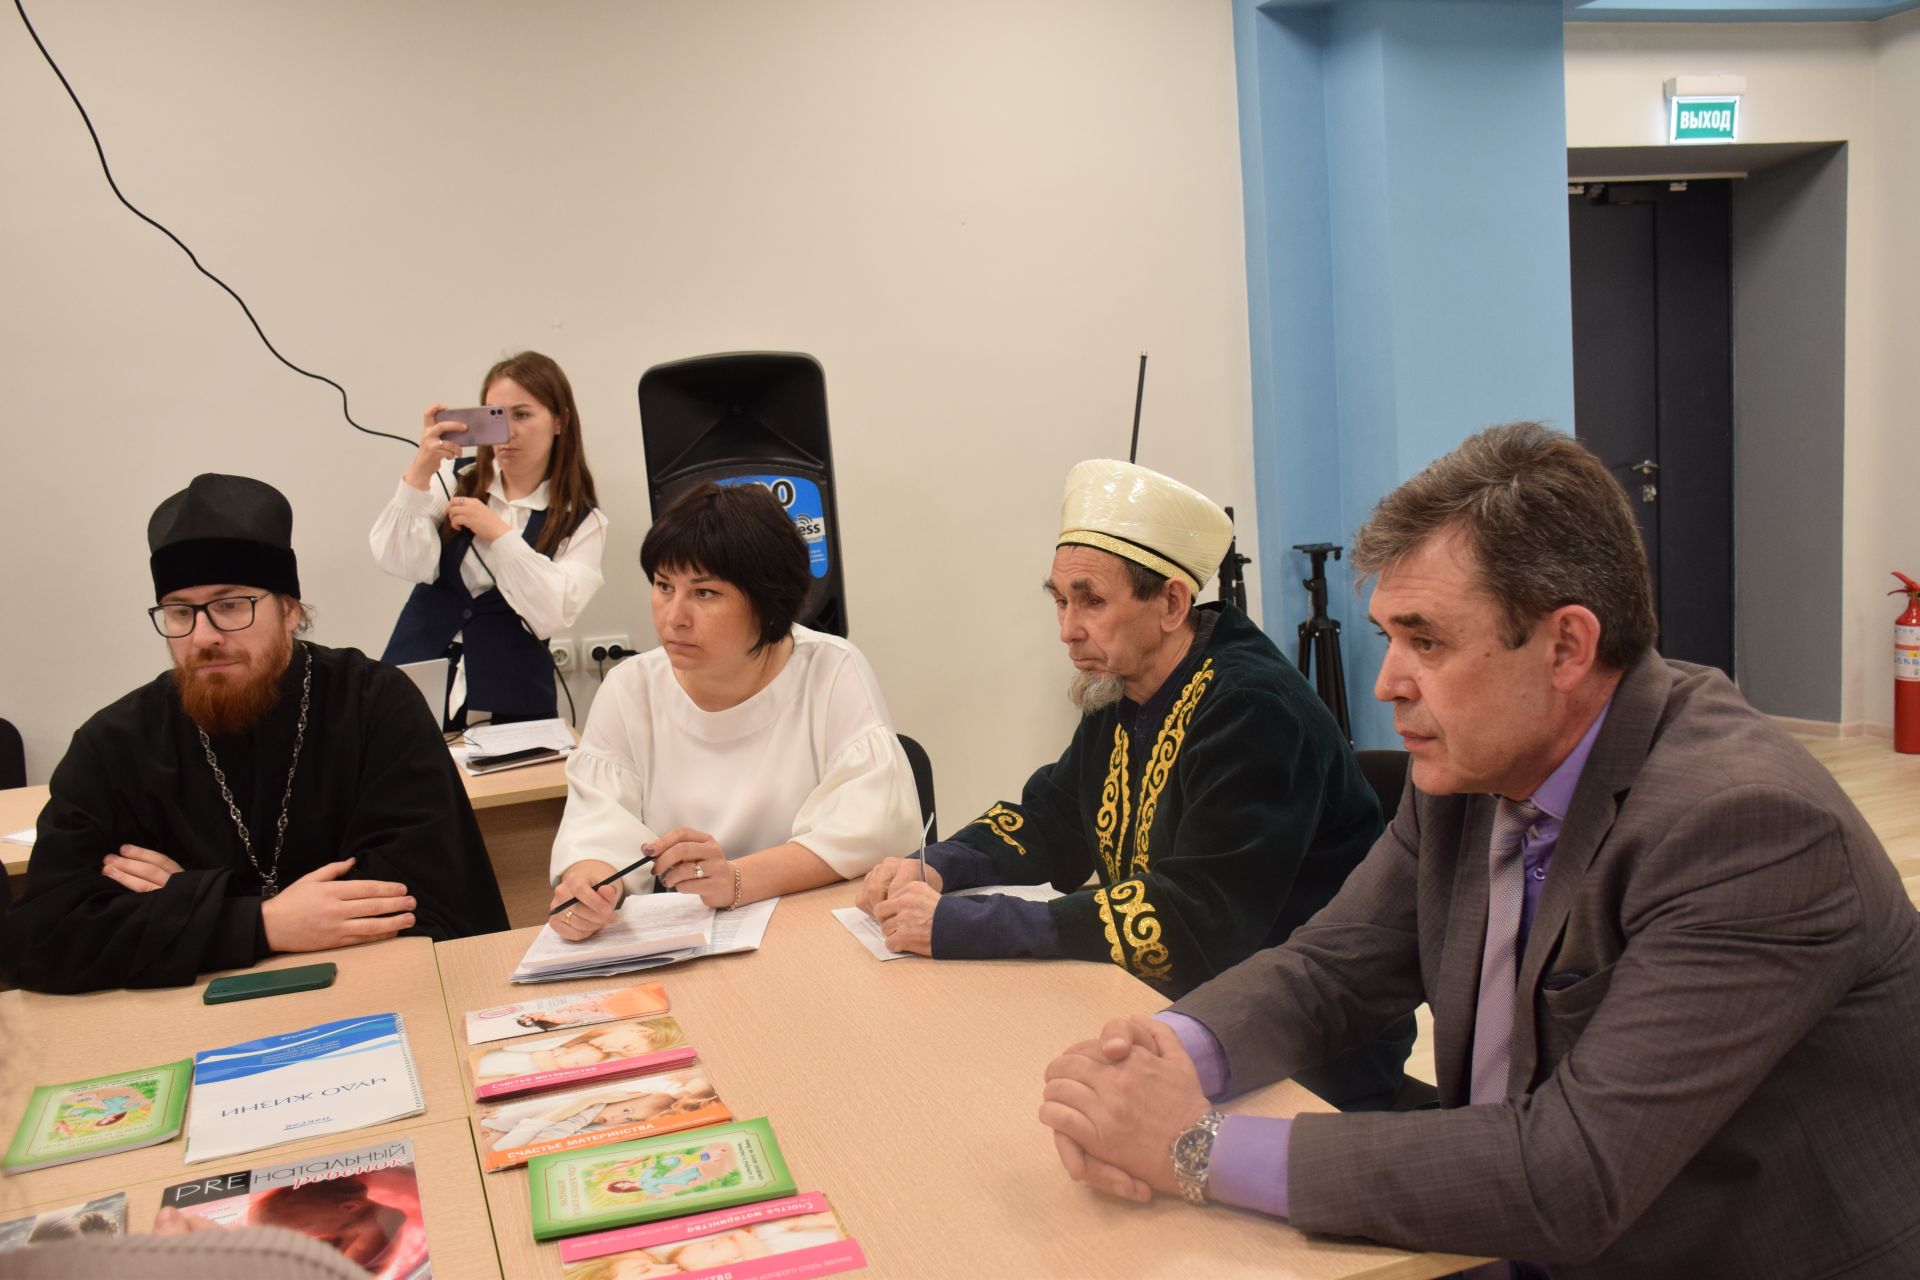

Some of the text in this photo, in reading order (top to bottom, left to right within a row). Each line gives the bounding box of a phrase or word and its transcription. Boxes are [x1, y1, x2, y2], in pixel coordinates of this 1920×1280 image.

[1680, 110, 1731, 131] ВЫХОД
[221, 1077, 387, 1118] ЧУДО ЖИЗНИ
[507, 1142, 562, 1159] СЧАСТЬЕ
[567, 1123, 655, 1147] МАТЕРИНСТВА
[175, 1173, 248, 1202] PRE
[766, 1202, 814, 1215] Счастье
